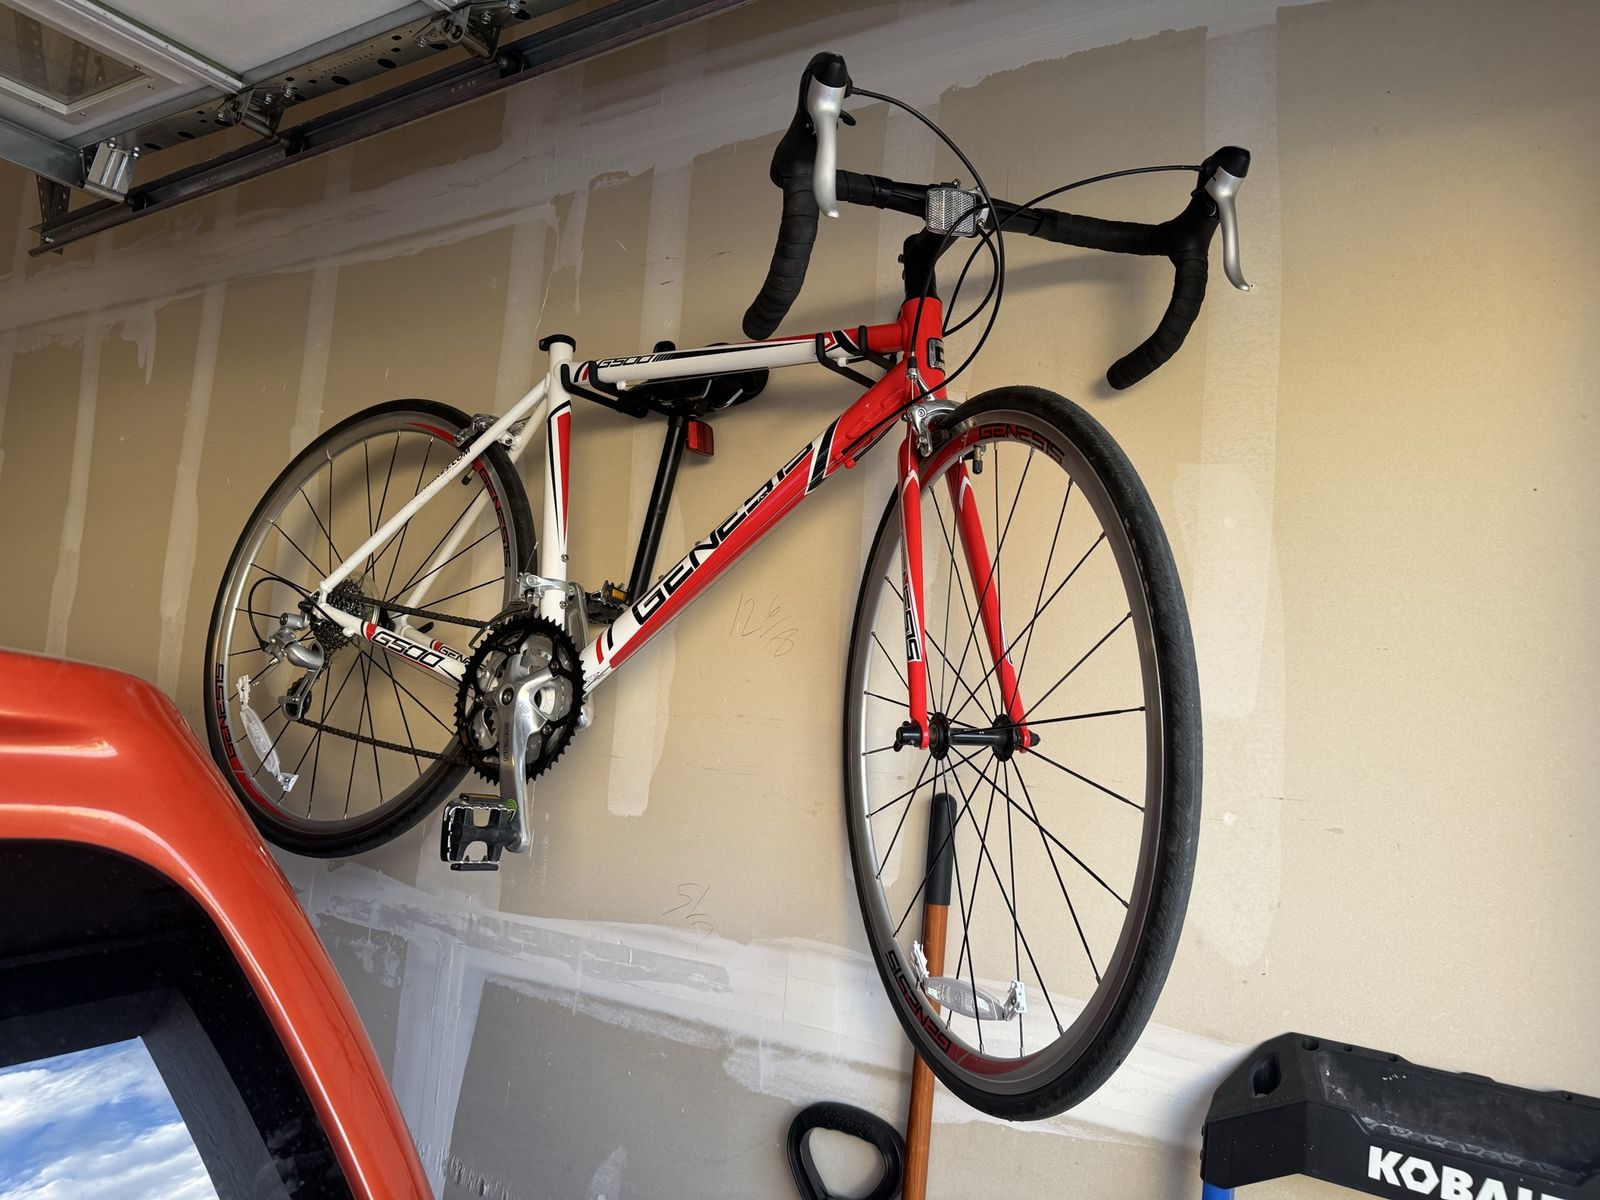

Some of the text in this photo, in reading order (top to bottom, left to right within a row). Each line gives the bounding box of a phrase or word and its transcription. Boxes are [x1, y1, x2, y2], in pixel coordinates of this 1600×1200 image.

[598, 354, 655, 368] G500
[372, 630, 445, 668] G500
[1367, 1145, 1569, 1200] KOBA
